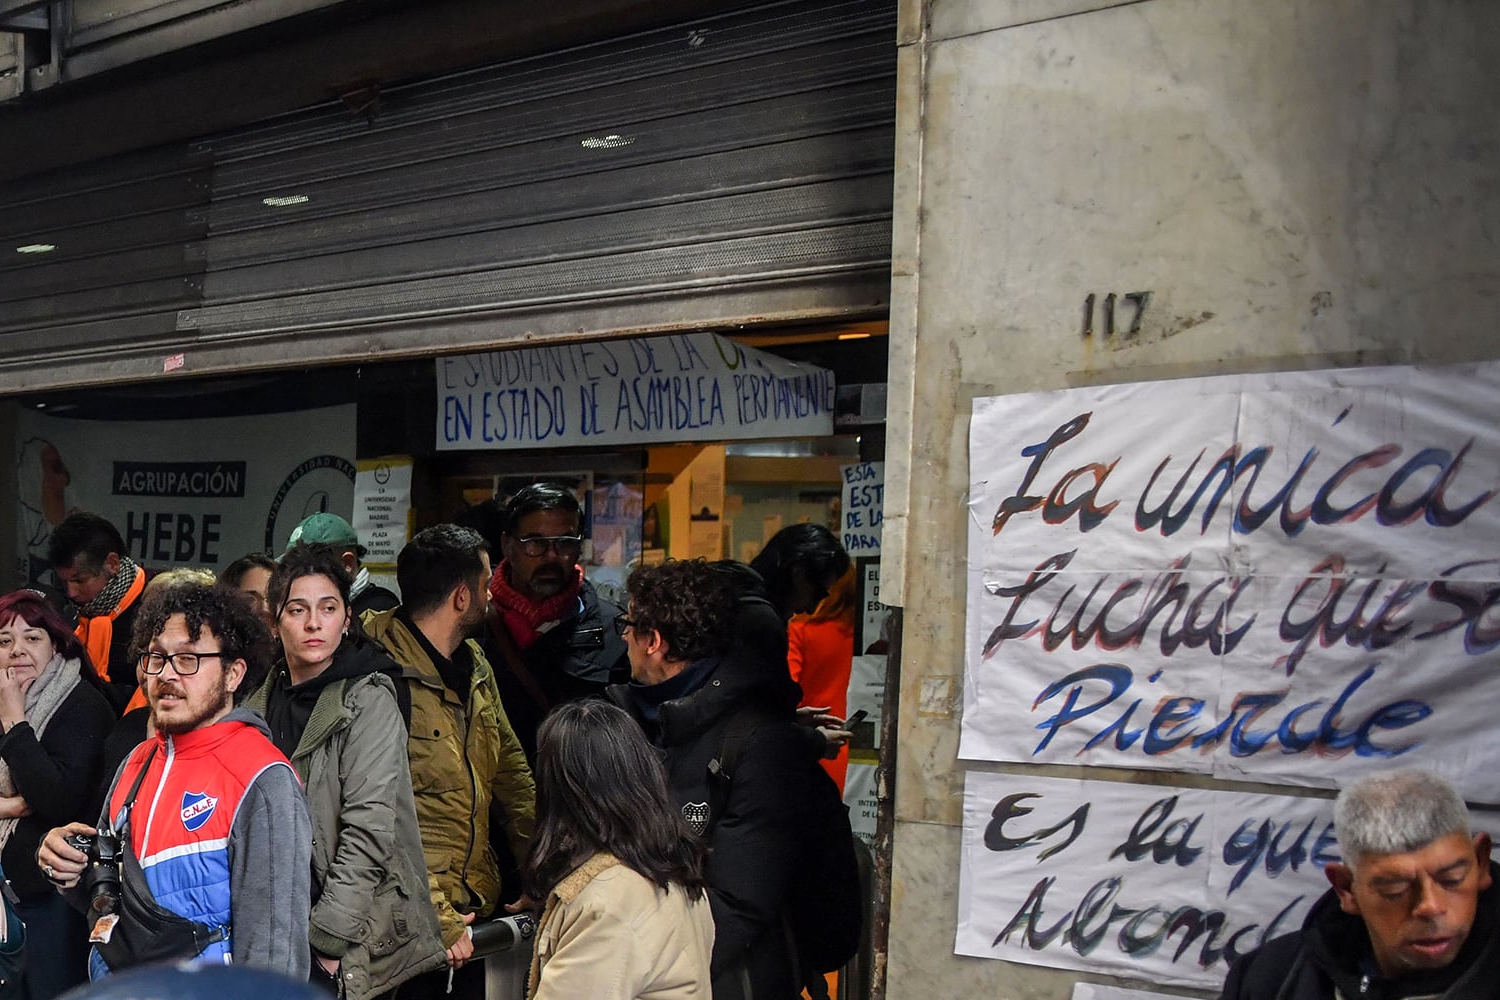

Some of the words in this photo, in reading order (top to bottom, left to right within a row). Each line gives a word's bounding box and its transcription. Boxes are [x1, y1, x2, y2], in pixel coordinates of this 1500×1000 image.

[1083, 292, 1155, 334] 117
[444, 394, 472, 442] EN
[483, 386, 565, 442] ESTADO
[580, 382, 605, 436] DE
[614, 376, 725, 433] ASAMBLEA
[119, 465, 240, 495] AGRUPACIÓN
[845, 464, 876, 484] ESTA
[992, 410, 1122, 537] La
[126, 511, 222, 565] HEBE
[846, 513, 862, 529] DE
[982, 548, 1260, 663] Lucha
[1031, 662, 1434, 760] Pierde
[984, 791, 1091, 865] Es
[1108, 795, 1204, 868] la
